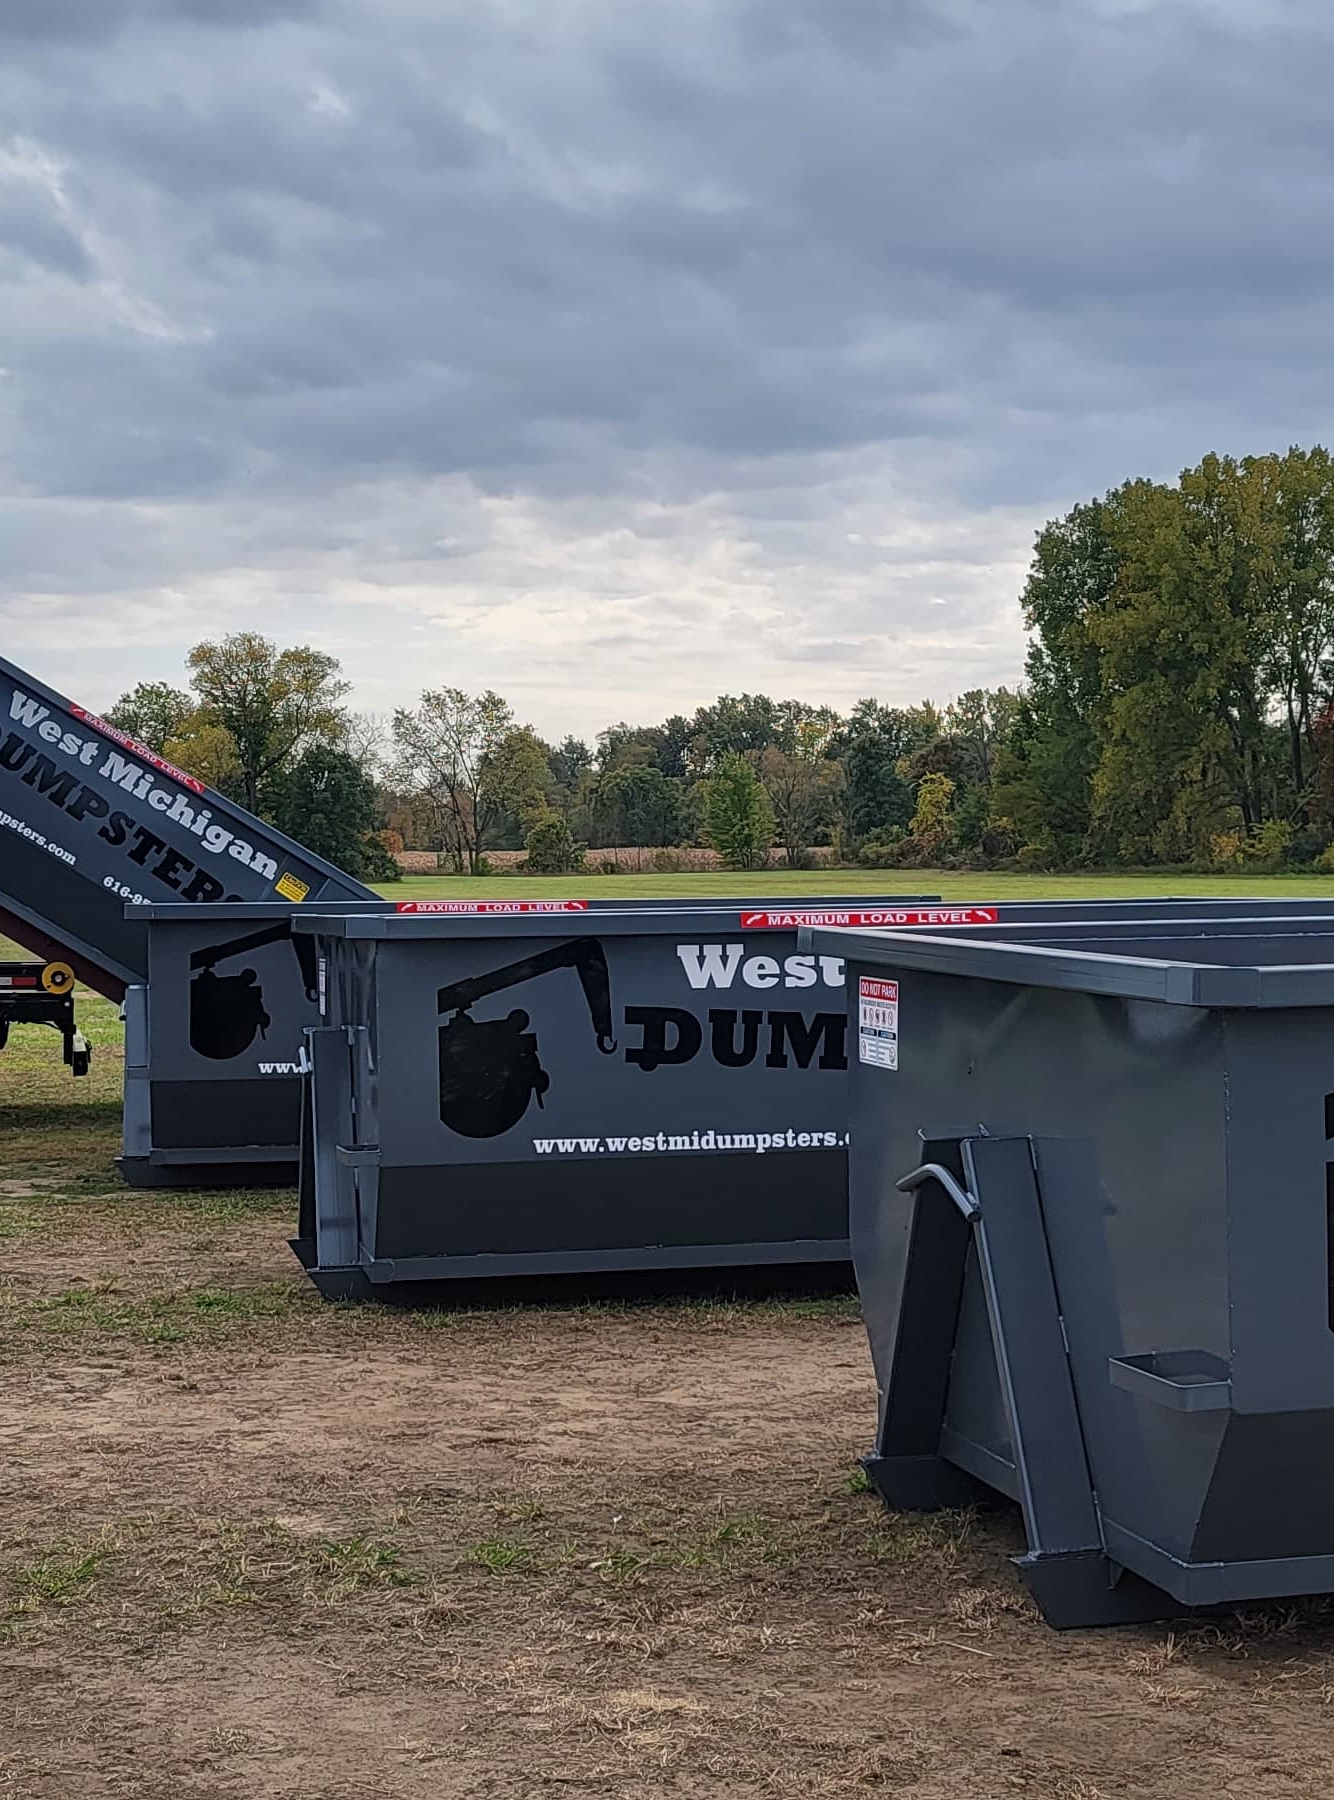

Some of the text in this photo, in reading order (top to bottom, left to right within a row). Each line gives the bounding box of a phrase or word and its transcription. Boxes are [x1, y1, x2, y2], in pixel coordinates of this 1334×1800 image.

[84, 712, 190, 785] MAXIMUM LOAD LEVEL
[8, 690, 279, 881] West Michigan
[417, 902, 567, 912] MAXIMUM LOAD LEVEL
[768, 912, 971, 925] MAXIMUM LOAD LEVEL
[676, 943, 846, 989] West
[861, 981, 897, 998] DO NOT PARK
